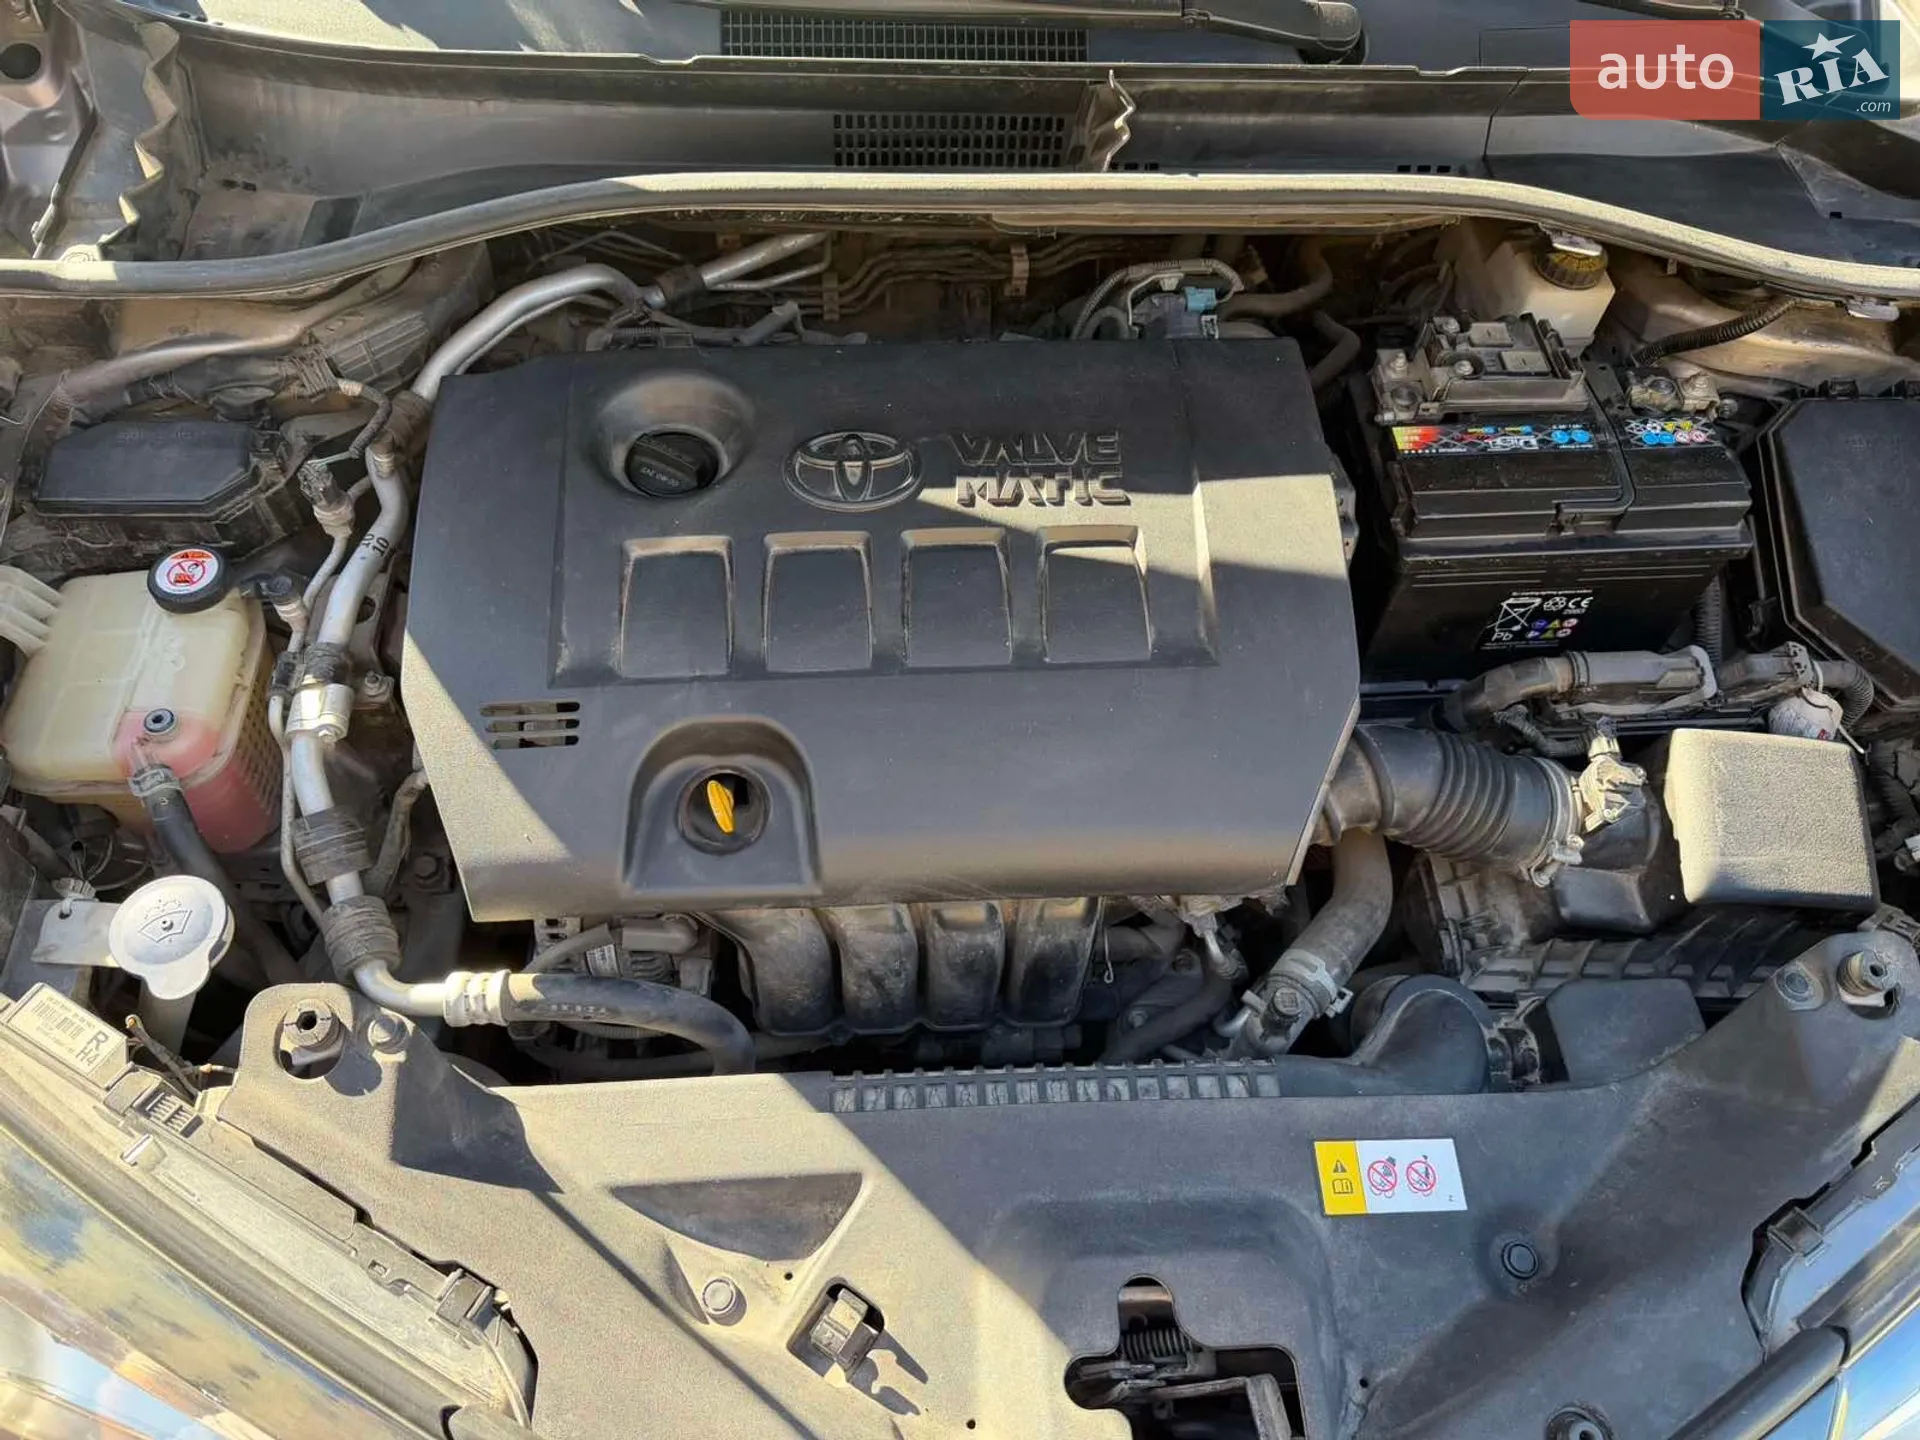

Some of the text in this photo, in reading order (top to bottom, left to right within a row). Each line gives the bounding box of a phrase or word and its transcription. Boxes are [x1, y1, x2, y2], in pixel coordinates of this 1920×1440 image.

[950, 431, 1121, 466] VALVE
[955, 467, 1131, 507] MATIC
[372, 537, 390, 556] 10
[1491, 632, 1513, 641] Pb
[87, 1030, 109, 1051] R
